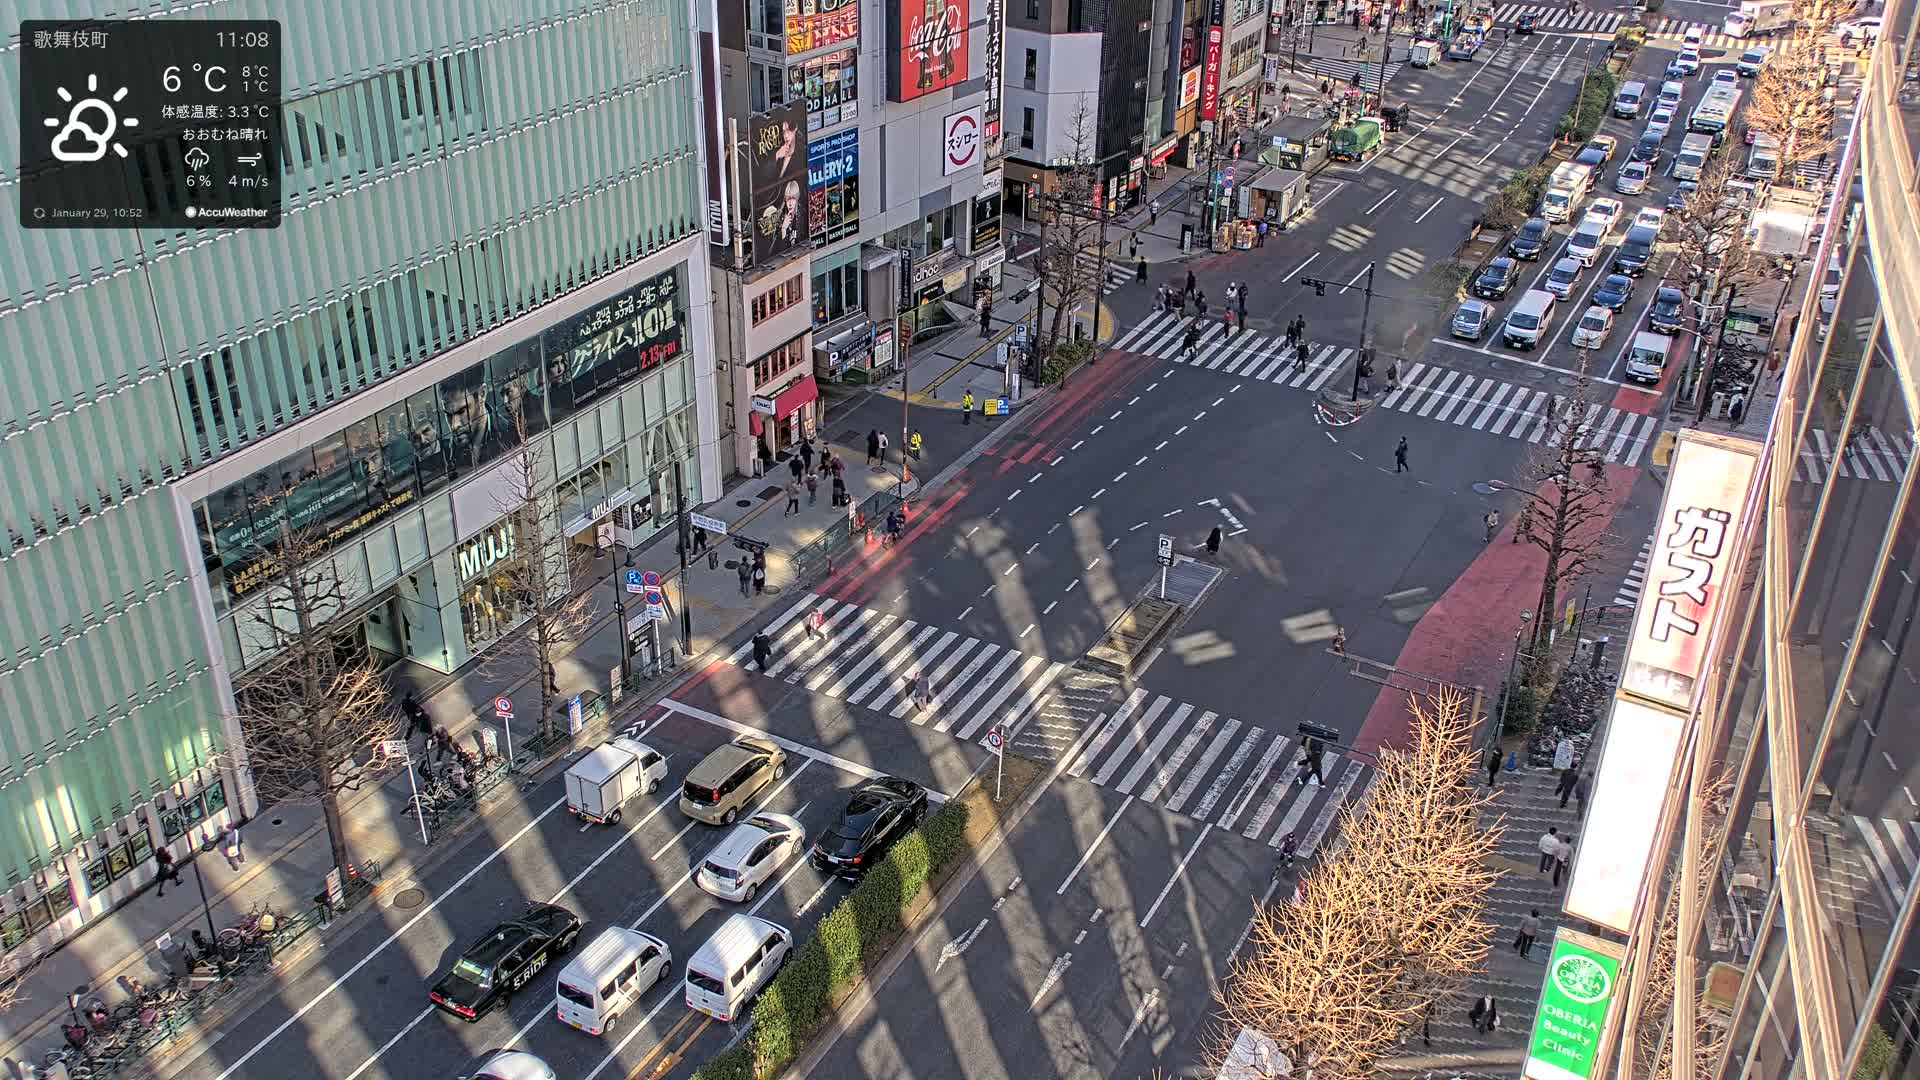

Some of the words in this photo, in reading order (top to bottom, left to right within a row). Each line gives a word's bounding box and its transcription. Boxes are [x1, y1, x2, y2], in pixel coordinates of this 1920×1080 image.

[1205, 45, 1220, 110] バーガーキング
[824, 88, 852, 106] HALL
[811, 141, 829, 154] SPORTS
[947, 133, 978, 152] スシロー
[808, 155, 853, 186] ALLERY-2
[710, 200, 722, 232] MUJI
[829, 225, 858, 240] BASKETBALL
[640, 343, 660, 368] 2.13
[662, 341, 676, 357] FRI
[829, 351, 839, 367] P
[592, 496, 614, 520] MUJI
[460, 523, 515, 581] MUJI
[1161, 539, 1169, 549] P
[1649, 506, 1732, 643] ガスト
[514, 958, 547, 991] S.RIDE
[1543, 1003, 1599, 1032] OBERIA
[1543, 1020, 1591, 1048] Beauty
[1543, 1037, 1585, 1062] Clinic
